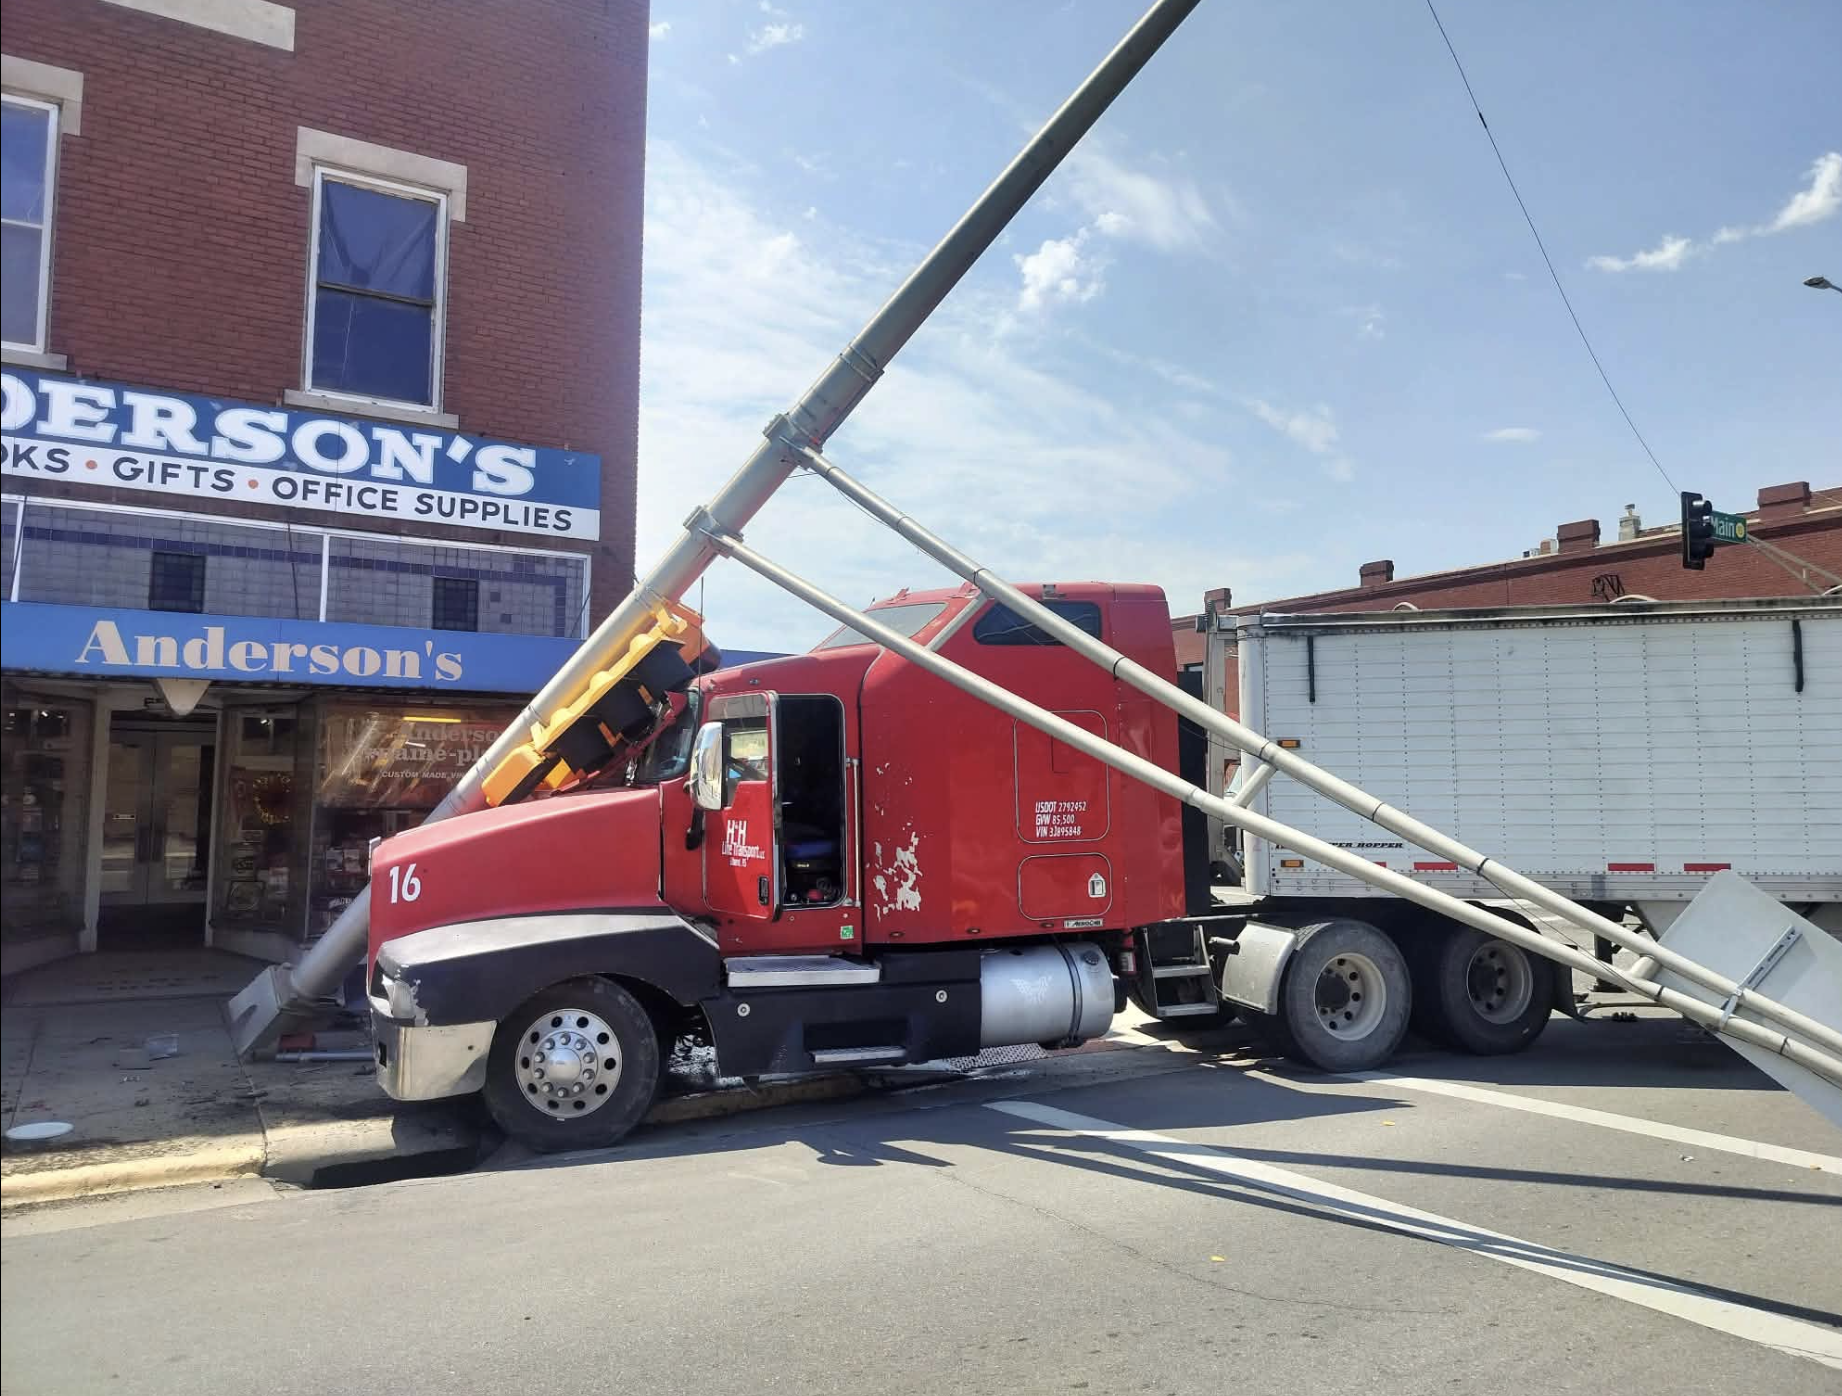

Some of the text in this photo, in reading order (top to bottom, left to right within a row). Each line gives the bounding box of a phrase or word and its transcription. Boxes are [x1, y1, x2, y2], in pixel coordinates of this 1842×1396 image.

[1, 442, 573, 533] KS GIFTS OFFICE SUPPLIES
[1710, 515, 1735, 538] Main
[75, 619, 463, 682] Anderson's
[381, 770, 419, 779] CUSTOM
[421, 771, 447, 779] MADE
[1035, 801, 1086, 813] USDOT 2792452
[1035, 813, 1075, 826] GVW 85,500
[1036, 826, 1048, 838] VIN
[389, 862, 421, 904] 16
